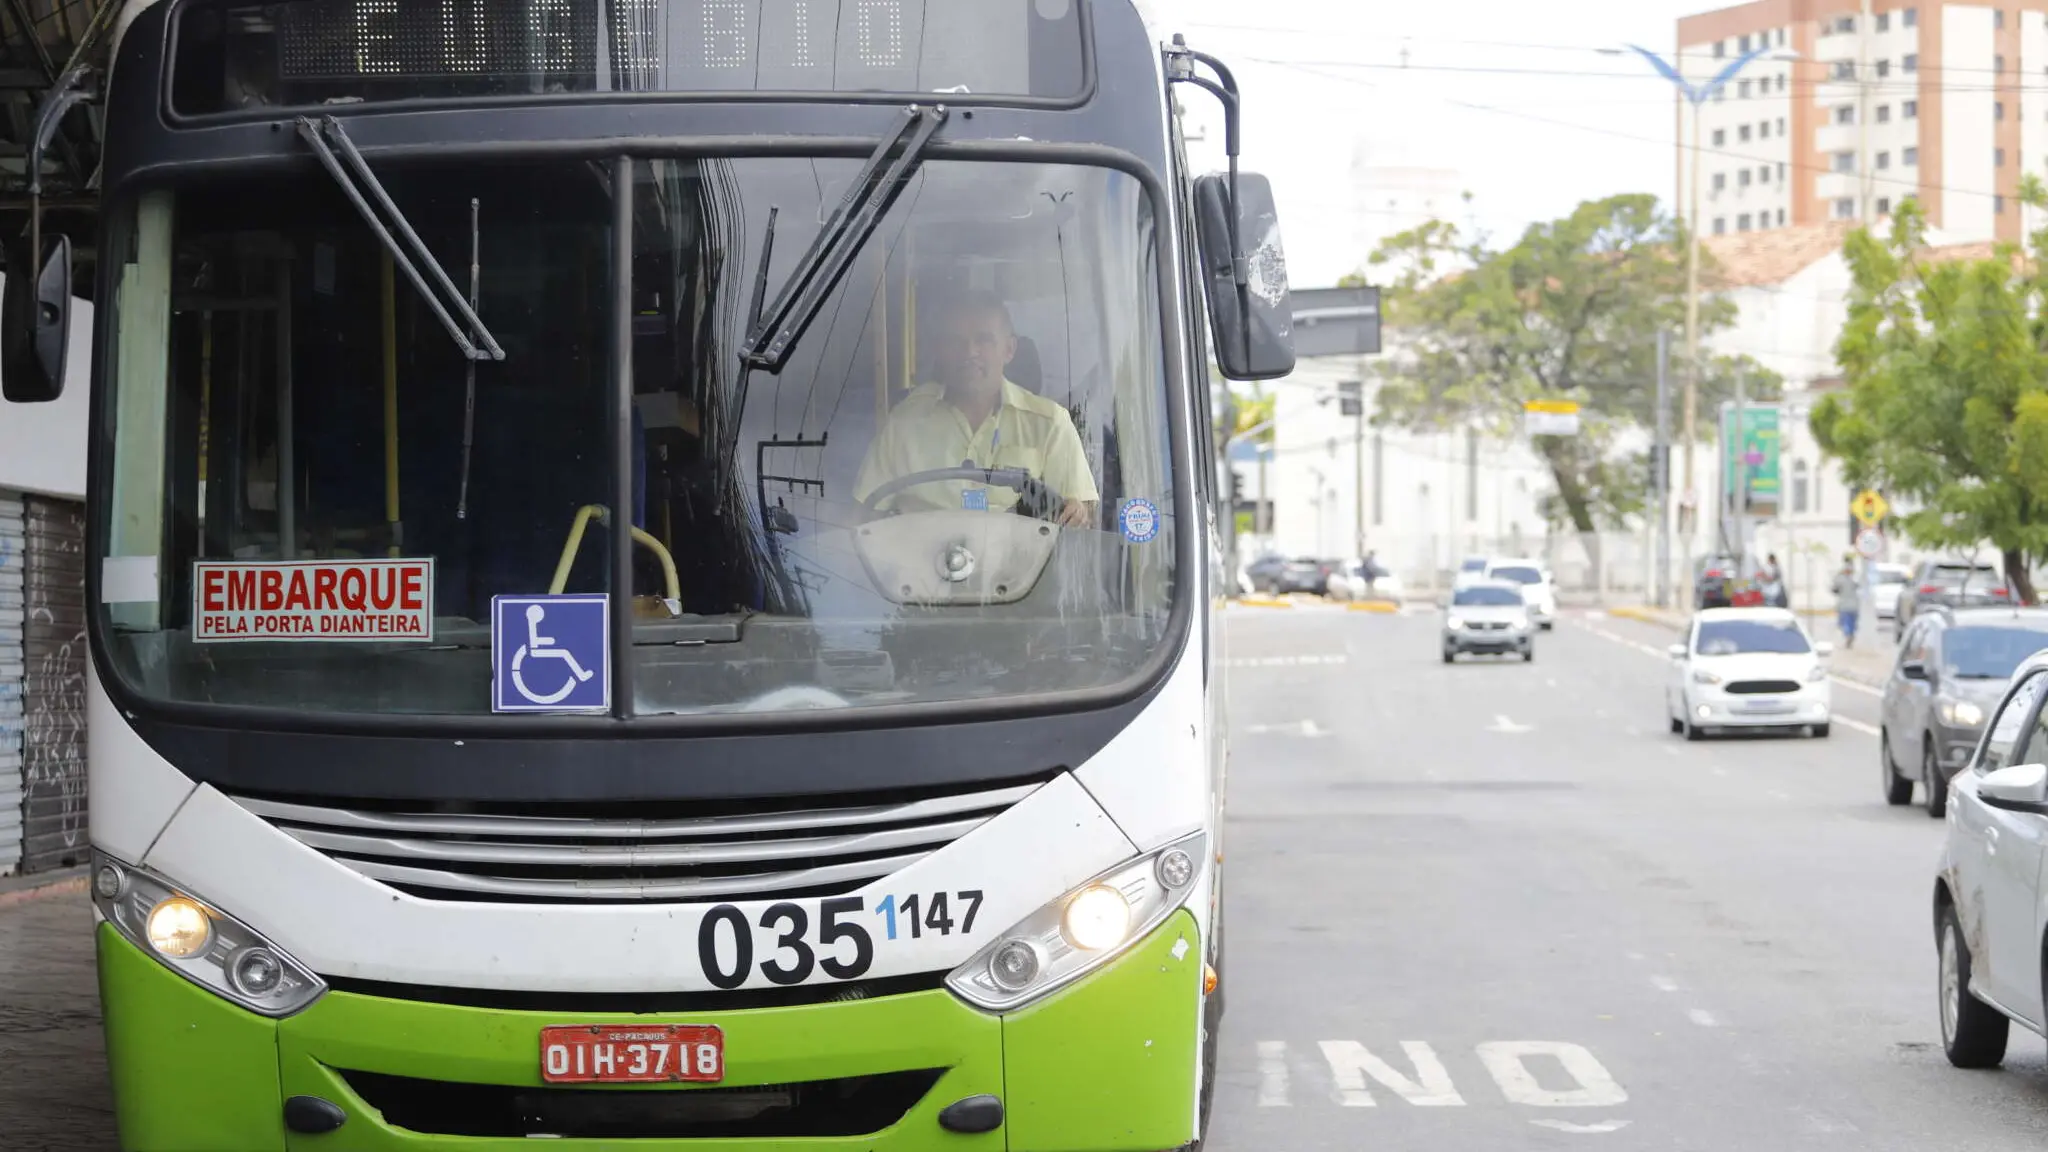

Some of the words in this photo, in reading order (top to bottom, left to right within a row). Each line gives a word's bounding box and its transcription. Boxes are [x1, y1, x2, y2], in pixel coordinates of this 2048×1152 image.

[203, 567, 423, 613] EMBARQUE
[203, 615, 248, 634] PELA
[254, 615, 314, 633] PORTA
[320, 614, 421, 633] DIANTEIRA
[698, 896, 874, 990] 035
